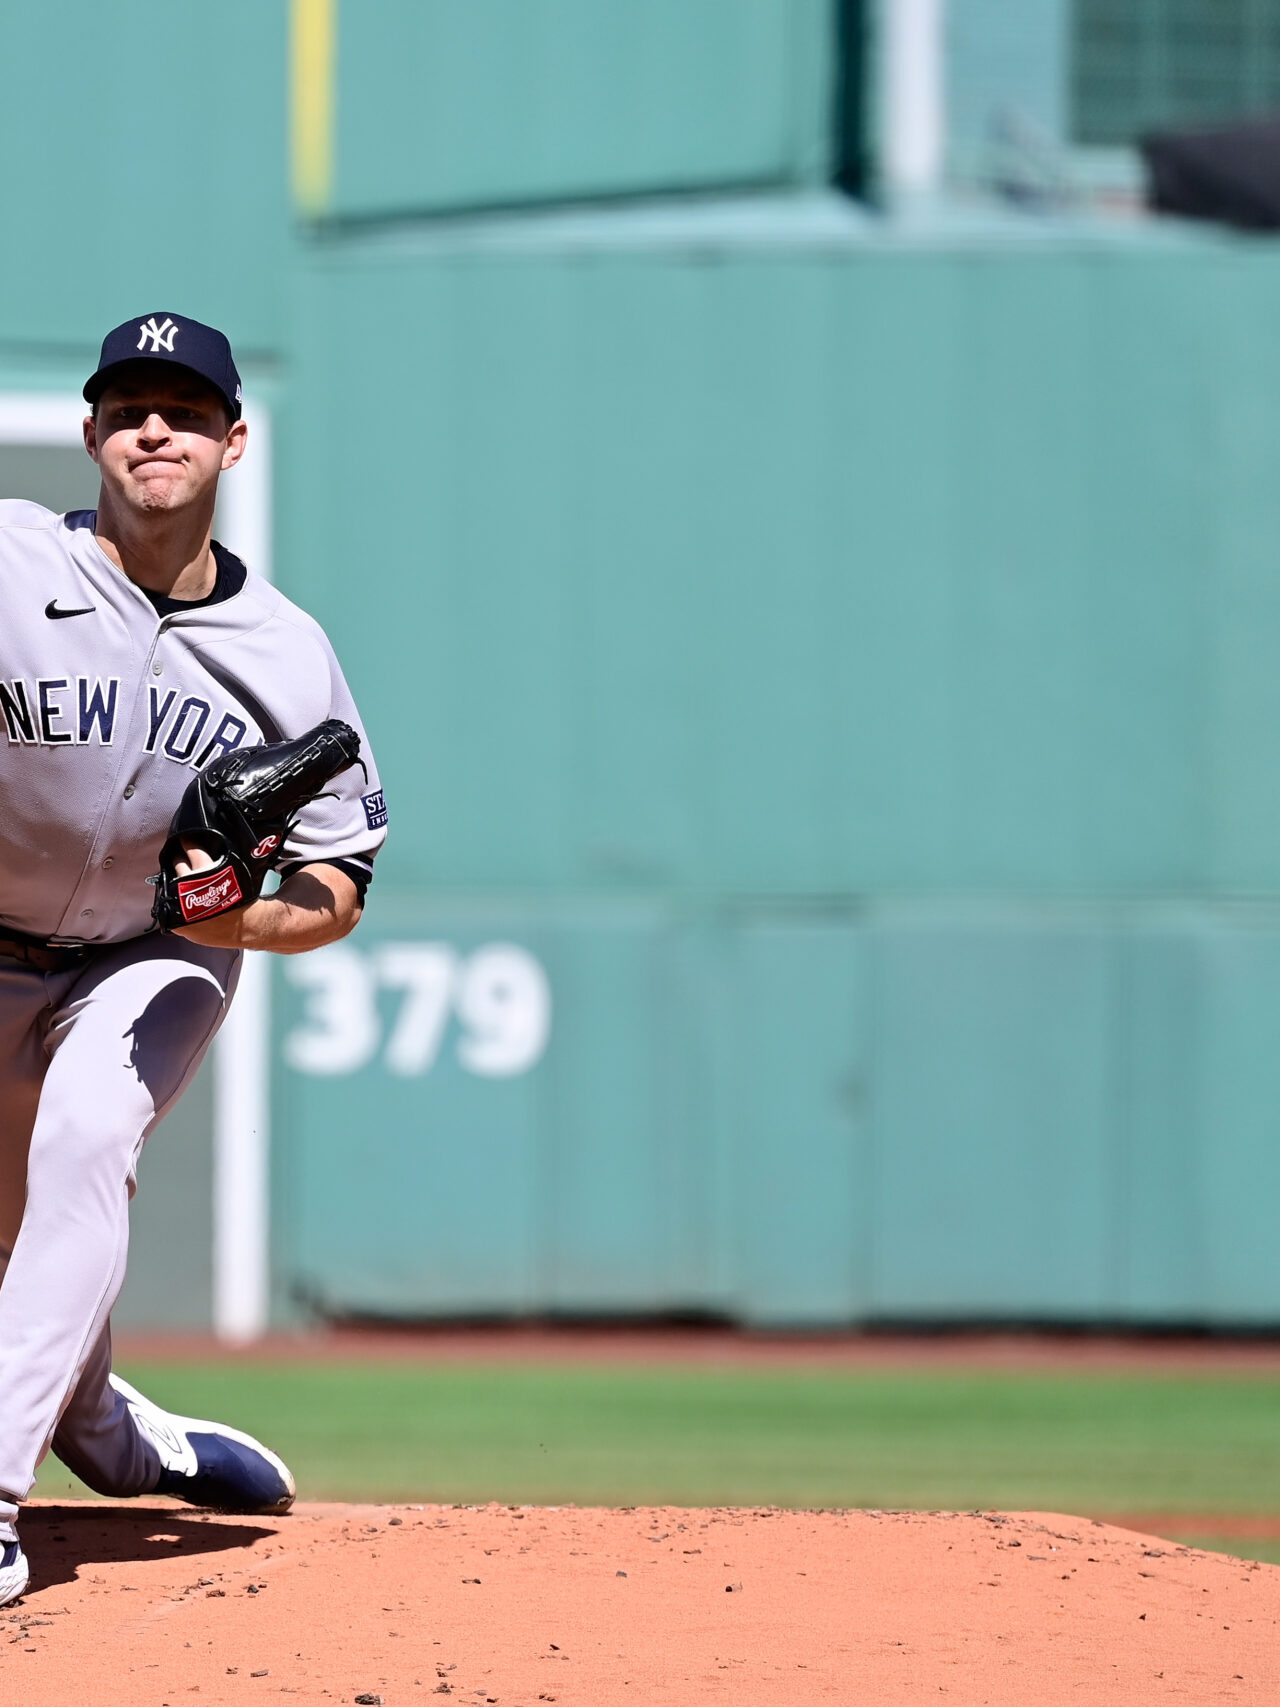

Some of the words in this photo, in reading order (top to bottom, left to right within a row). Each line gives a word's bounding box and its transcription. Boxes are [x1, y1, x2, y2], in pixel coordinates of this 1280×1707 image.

[136, 317, 179, 352] NY
[142, 684, 265, 773] YOR
[185, 879, 232, 909] Rawlings
[281, 941, 551, 1078] 379
